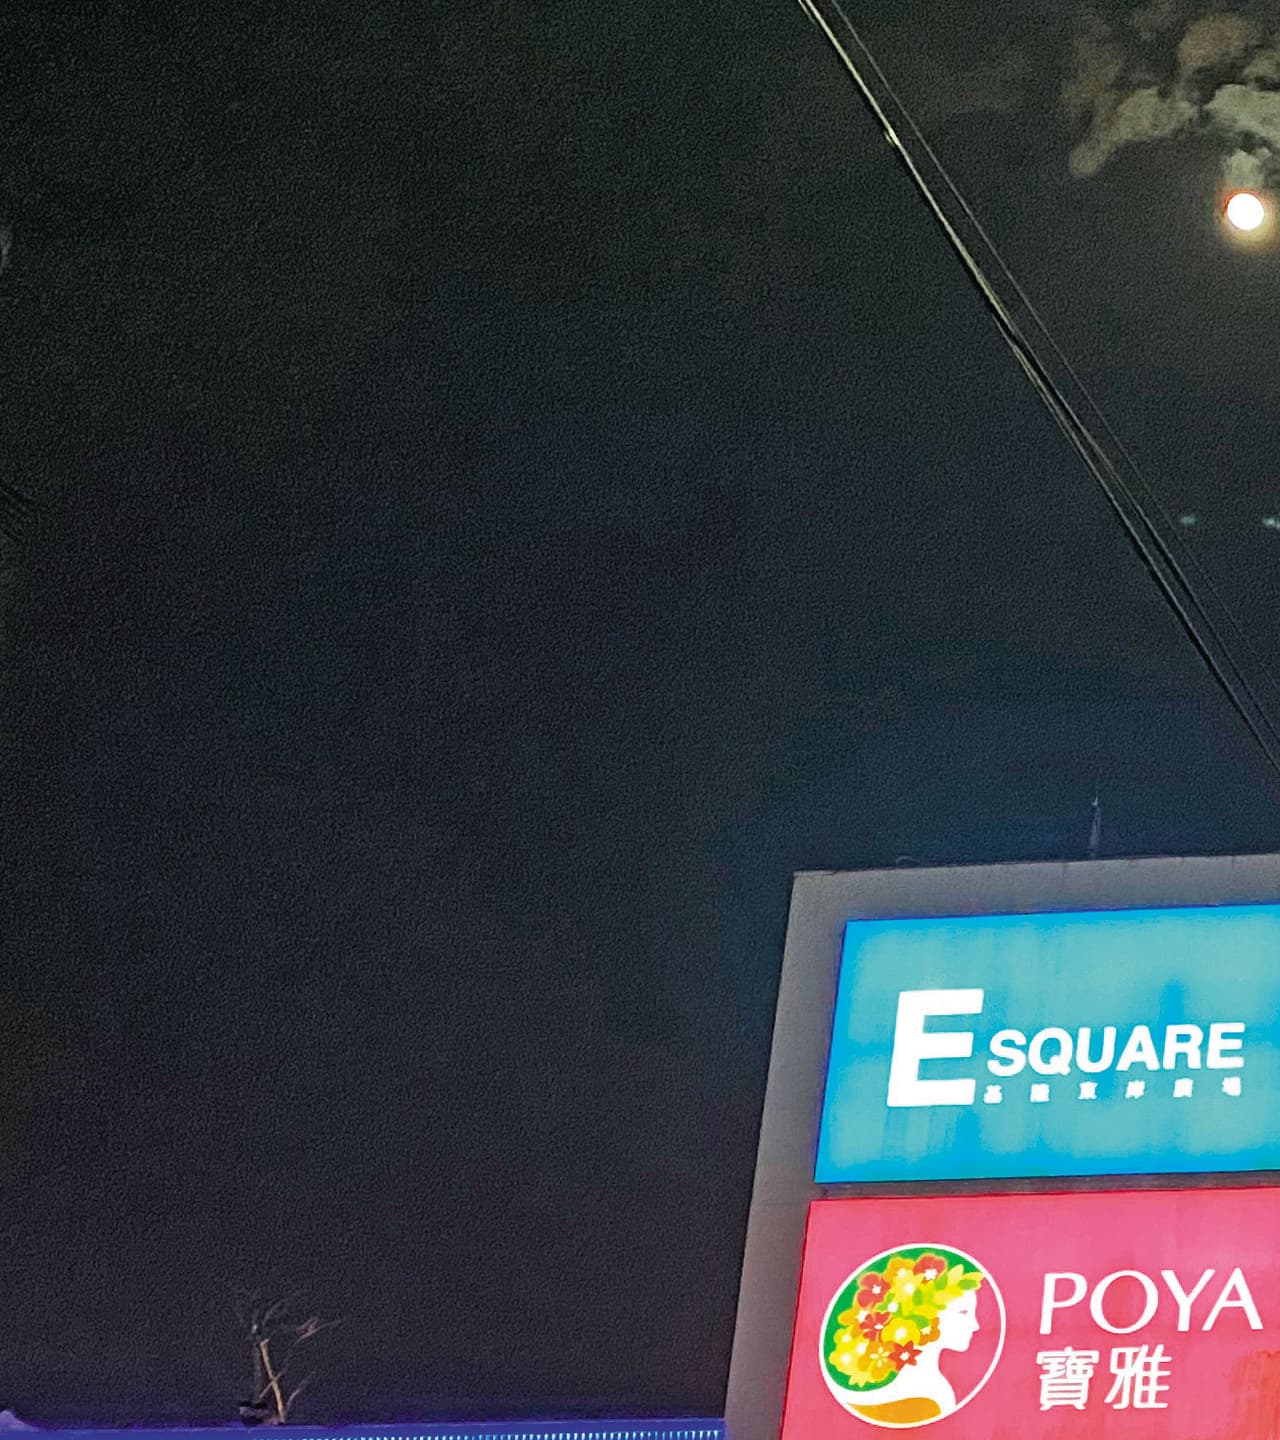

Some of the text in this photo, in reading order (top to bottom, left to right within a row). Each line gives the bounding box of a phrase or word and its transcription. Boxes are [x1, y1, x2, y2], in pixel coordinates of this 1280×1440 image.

[886, 989, 1246, 1108] E SQUARE
[1040, 1268, 1264, 1335] POYA
[1036, 1346, 1172, 1412] 寶雅
